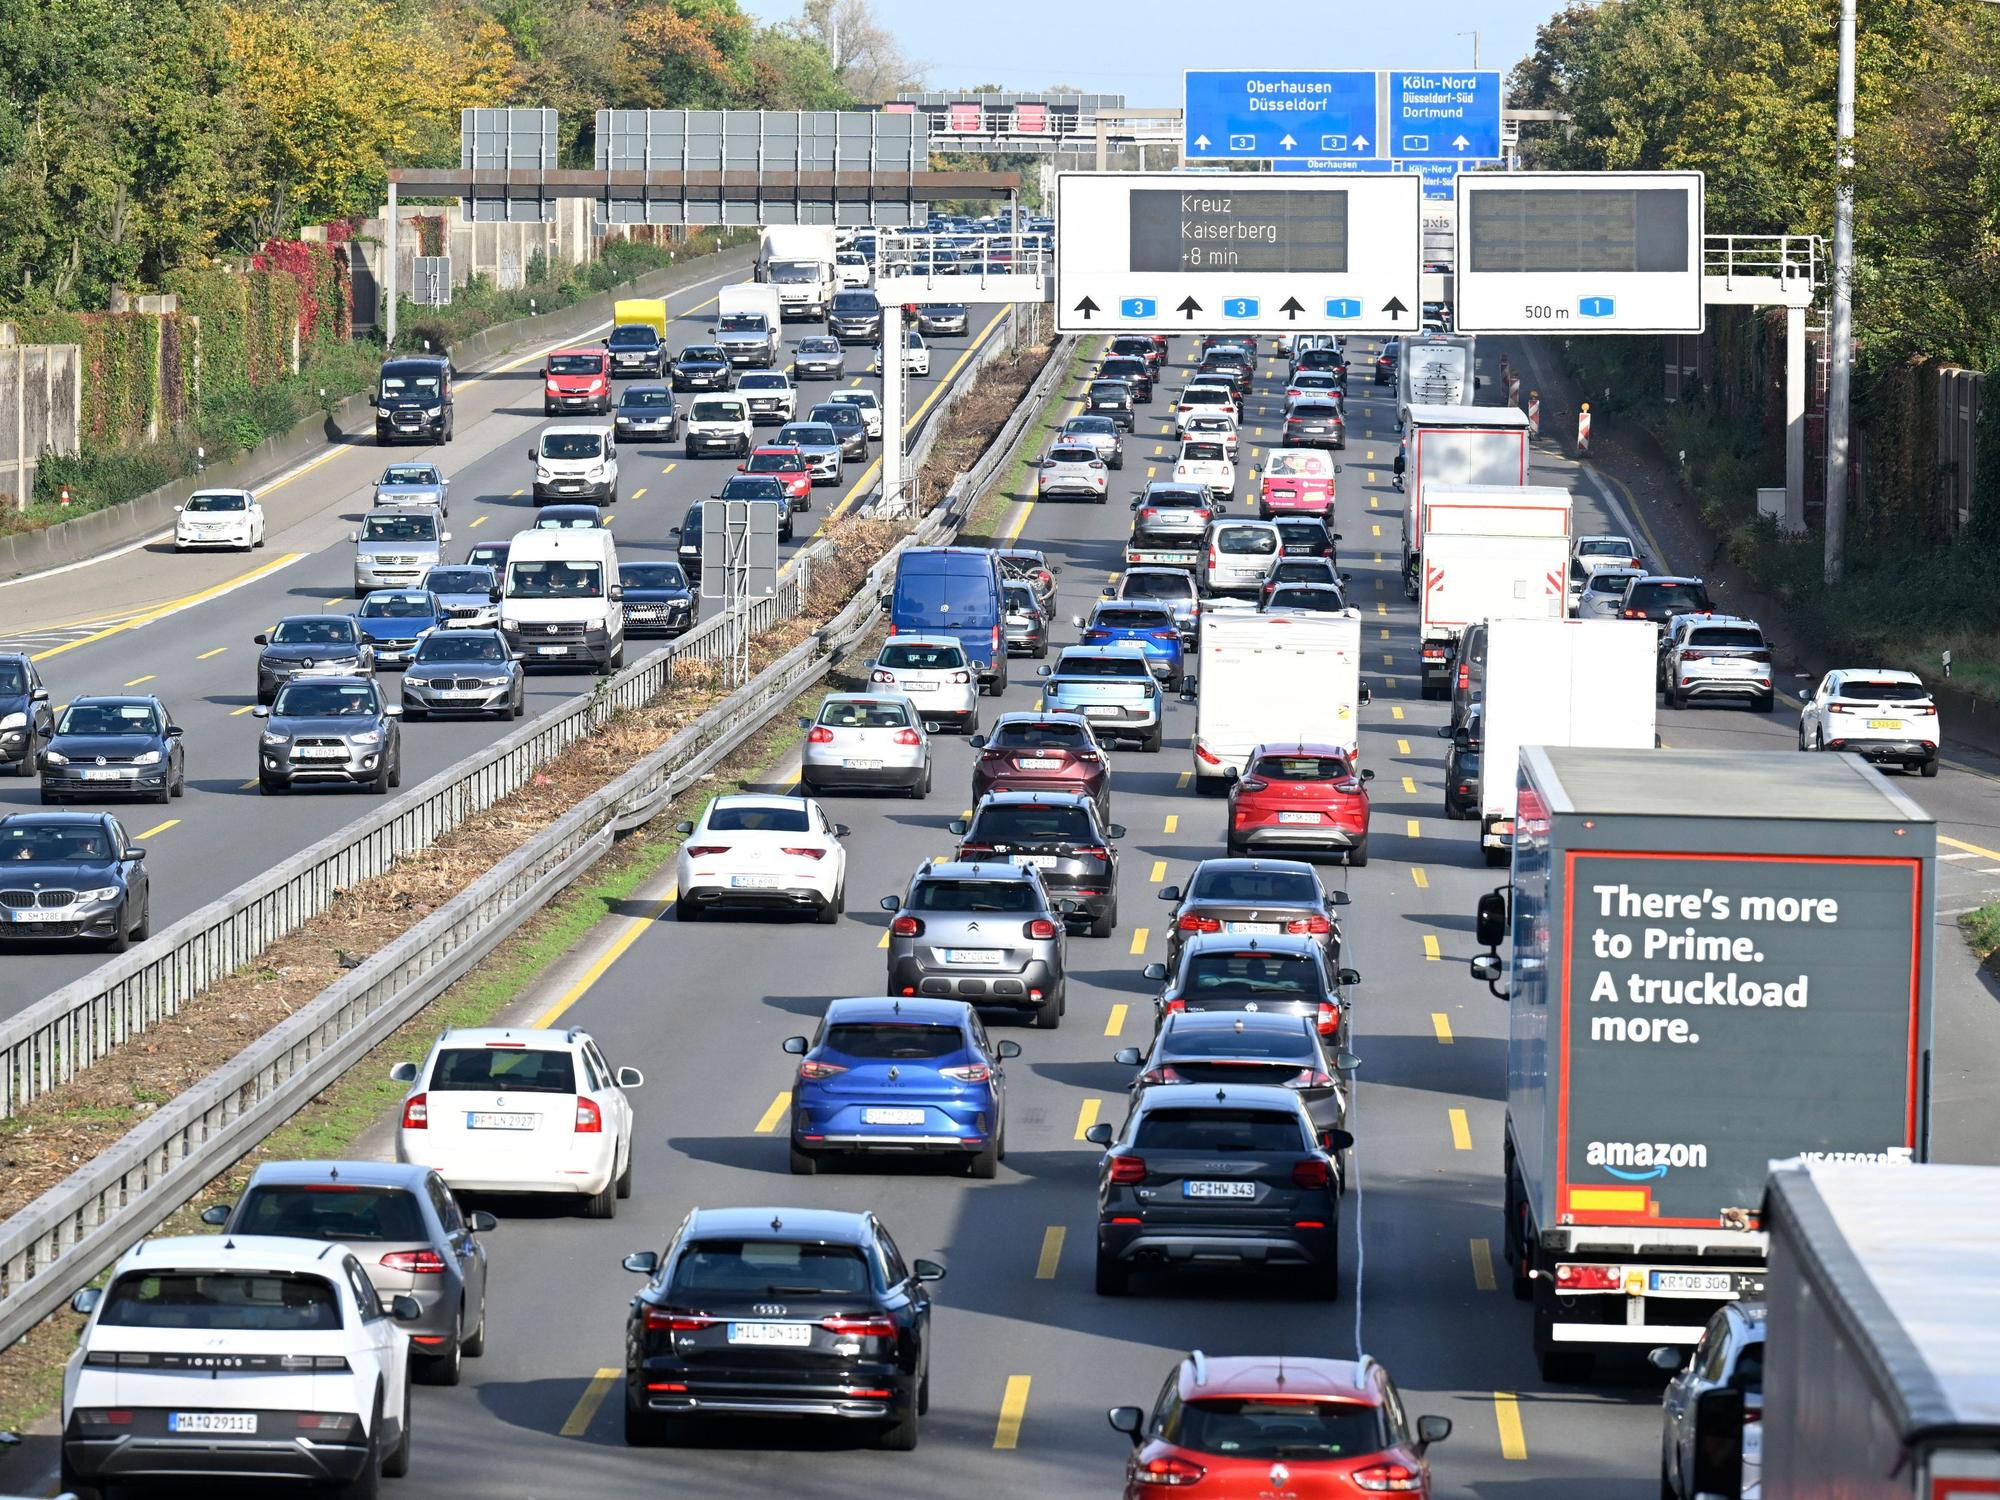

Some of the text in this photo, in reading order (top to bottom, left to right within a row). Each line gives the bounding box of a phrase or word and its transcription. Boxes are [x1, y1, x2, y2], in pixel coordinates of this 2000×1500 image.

[1246, 79, 1332, 94] Oberhausen
[1402, 76, 1477, 90] Köln-Nord
[1249, 97, 1328, 111] Düsseldorf
[1402, 91, 1474, 104] Düsseldorf-Süd
[1402, 106, 1464, 118] Dortmund
[1239, 138, 1246, 148] 3
[1330, 138, 1337, 148] 3
[1306, 160, 1358, 169] Oberhausen
[1408, 165, 1452, 174] Köln-Nord
[1181, 195, 1232, 213] Kreuz
[1181, 221, 1277, 243] Kaiserberg
[1182, 247, 1238, 265] +8 min
[1134, 302, 1143, 315] 3
[1237, 302, 1246, 315] 3
[1340, 302, 1347, 315] 1
[1525, 305, 1569, 319] 500 m
[1594, 300, 1600, 314] 1
[1592, 883, 1839, 923] There's more
[1591, 927, 1765, 963] to Prime.
[1589, 970, 1809, 1008] A truckload
[1591, 1015, 1700, 1044] more.
[474, 1114, 486, 1125] PF
[1586, 1141, 1707, 1168] amazon
[1191, 1182, 1254, 1197] OF HW 343
[1659, 1274, 1729, 1290] KR QB 306
[736, 1325, 759, 1339] MIL
[788, 1326, 808, 1341] 111
[177, 1415, 194, 1429] MA
